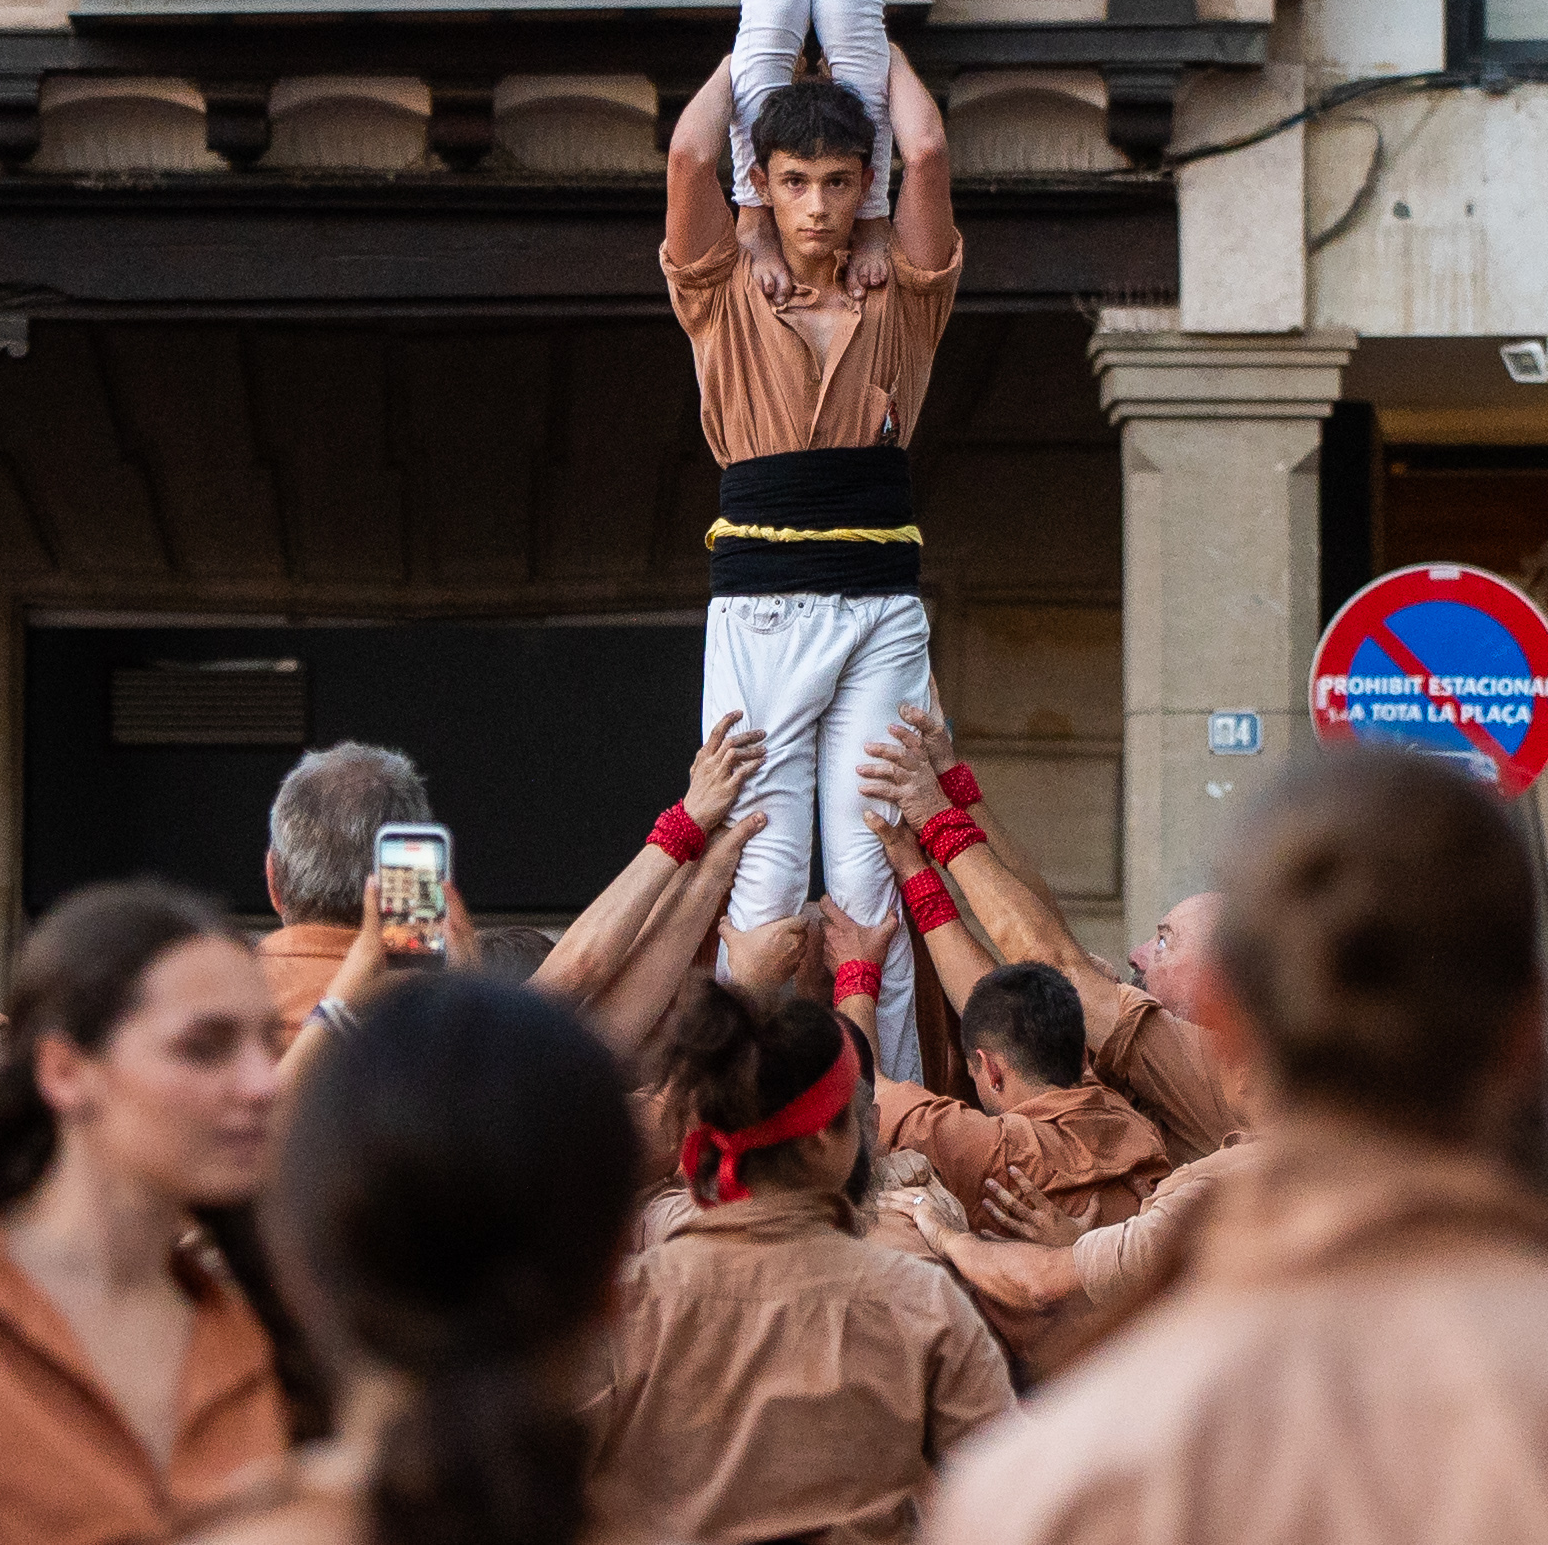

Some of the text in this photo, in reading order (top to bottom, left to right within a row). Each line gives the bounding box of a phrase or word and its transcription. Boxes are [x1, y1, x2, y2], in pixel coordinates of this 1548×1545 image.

[1320, 674, 1425, 697] PROHIBIT
[1371, 703, 1423, 722] TOTA
[1426, 703, 1456, 724] LA
[1459, 703, 1531, 728] PLAÇA
